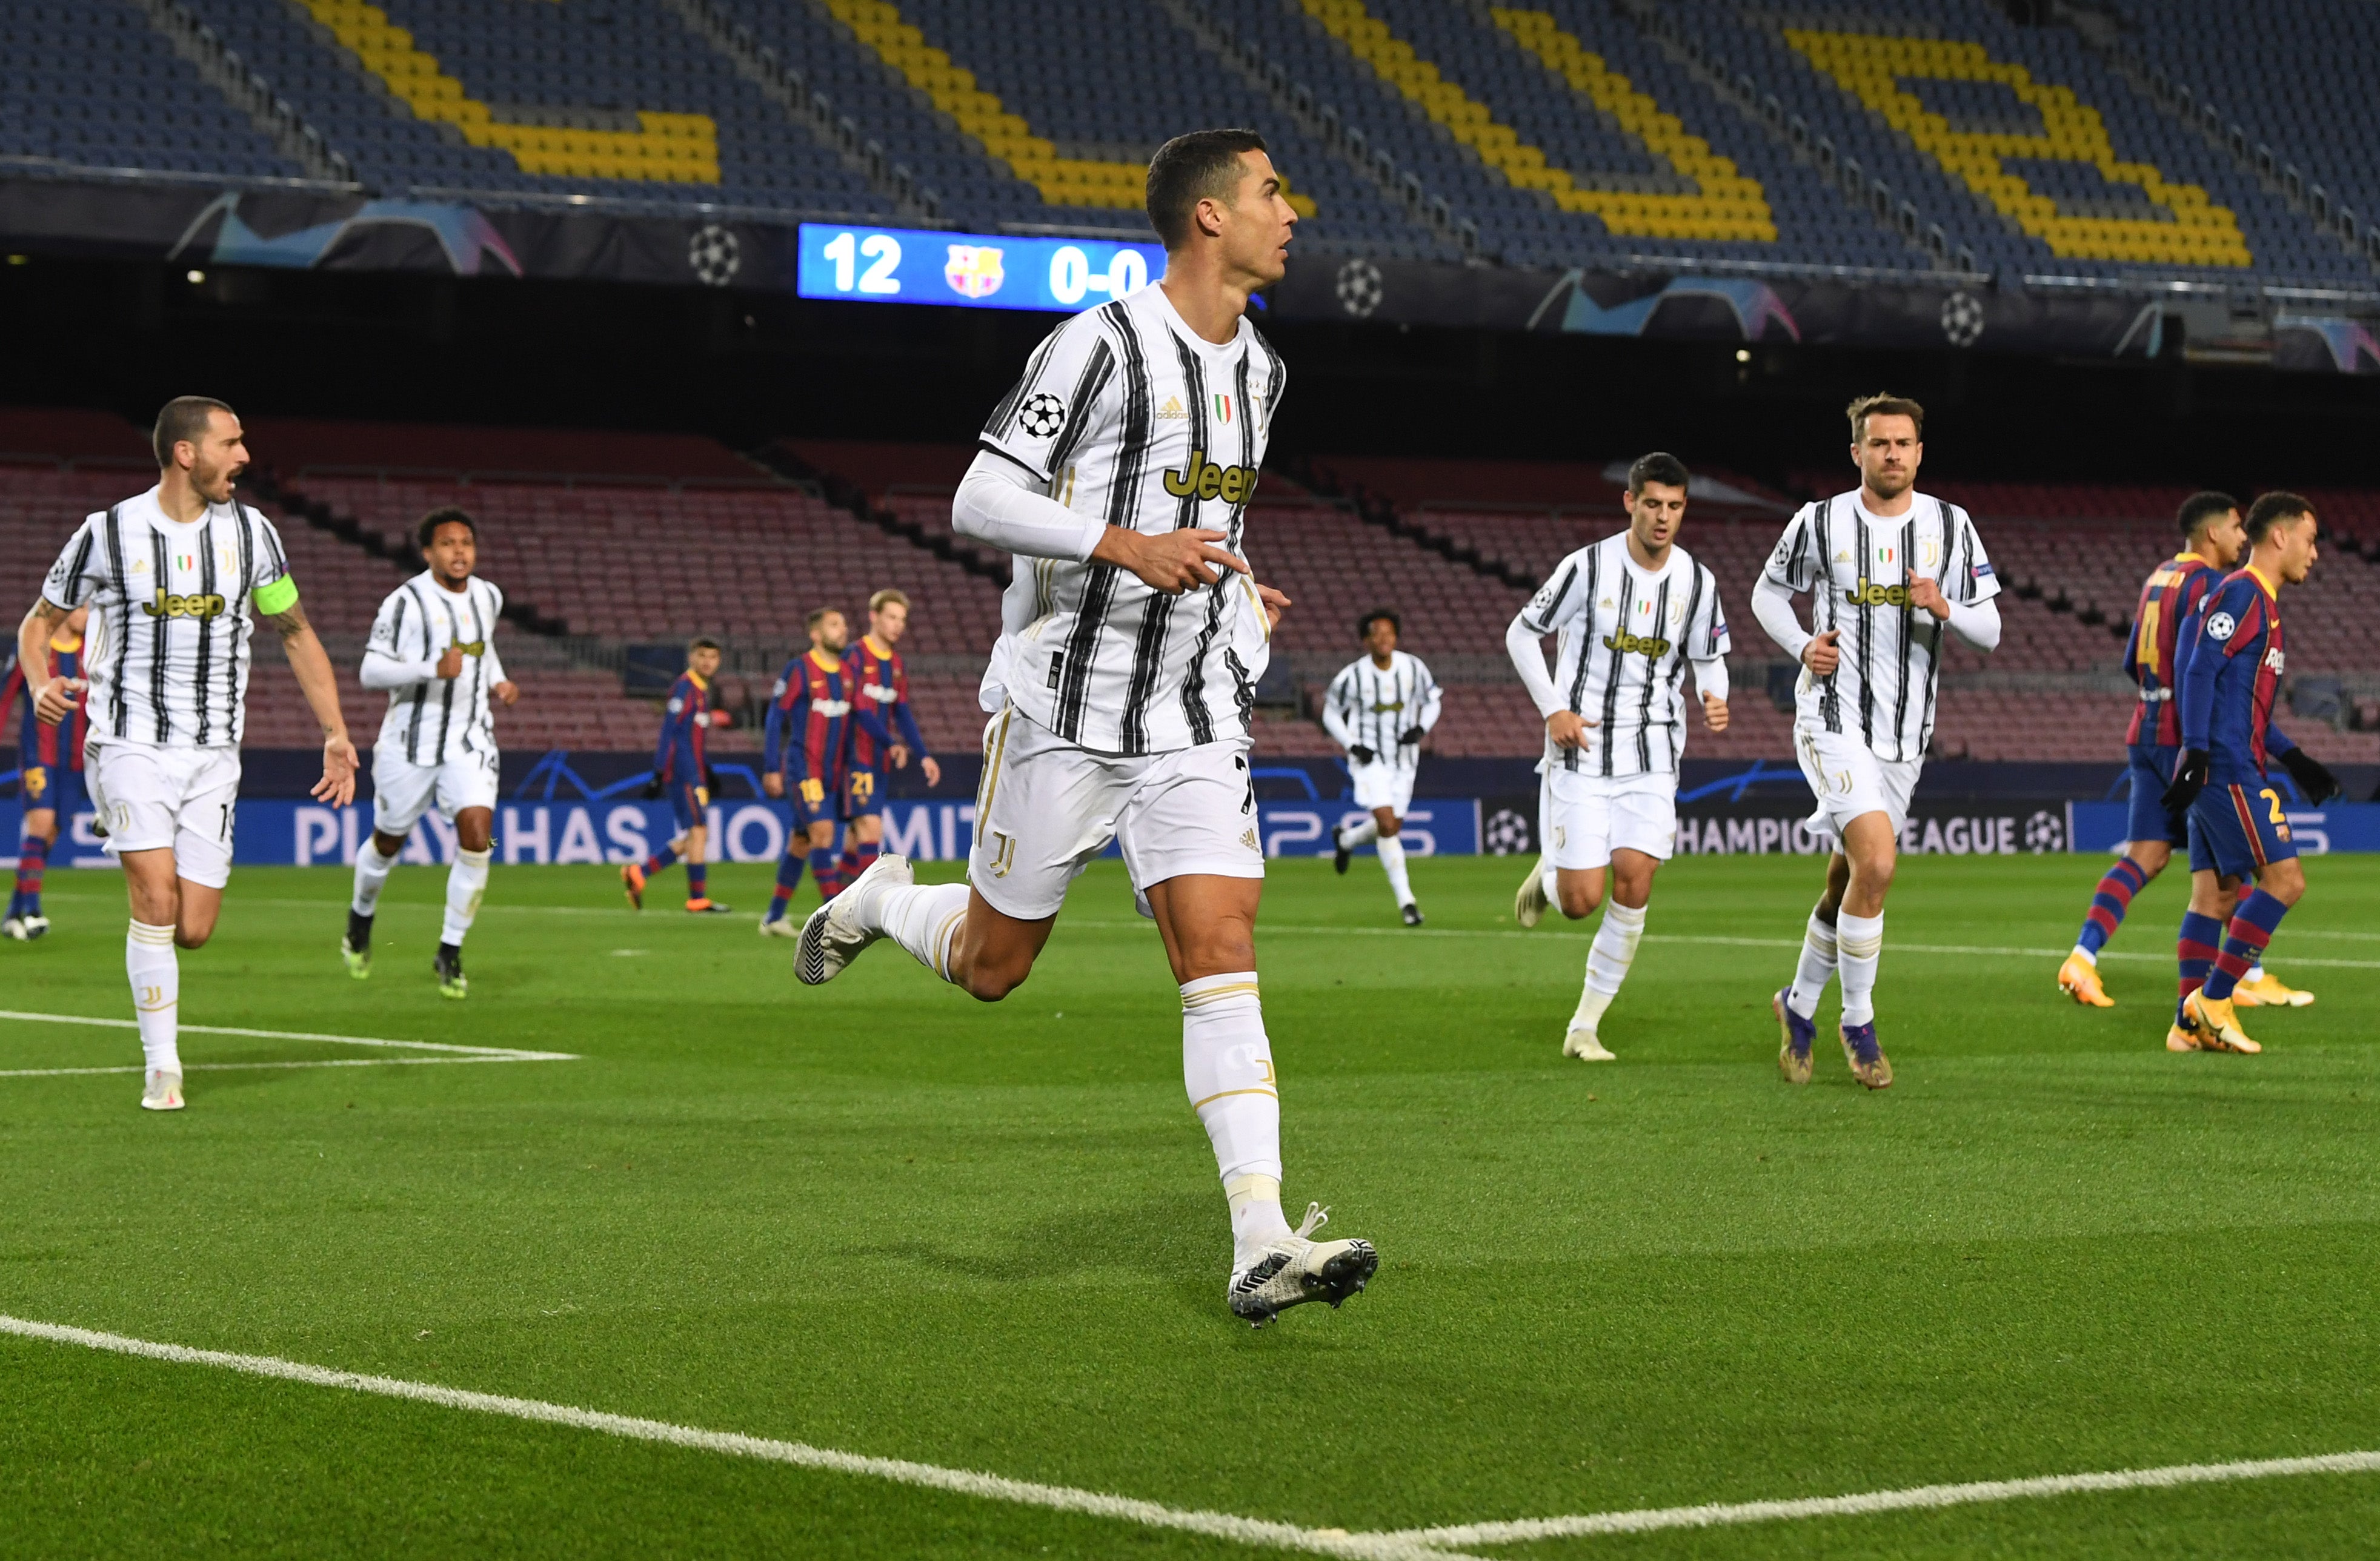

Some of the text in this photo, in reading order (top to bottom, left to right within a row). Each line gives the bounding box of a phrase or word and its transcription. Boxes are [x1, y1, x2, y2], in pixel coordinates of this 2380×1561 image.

[823, 233, 902, 294] 12
[1049, 245, 1148, 303] 0-0
[1156, 409, 1188, 419] adidas
[1163, 446, 1258, 517] Jeep
[142, 587, 225, 621] Jeep
[1603, 626, 1670, 661] Jeep
[851, 771, 874, 796] 21
[1235, 755, 1252, 815] 7
[2259, 788, 2285, 824] 2
[503, 806, 648, 865] HAS
[1675, 817, 2018, 855] HAMPIO EAGUE
